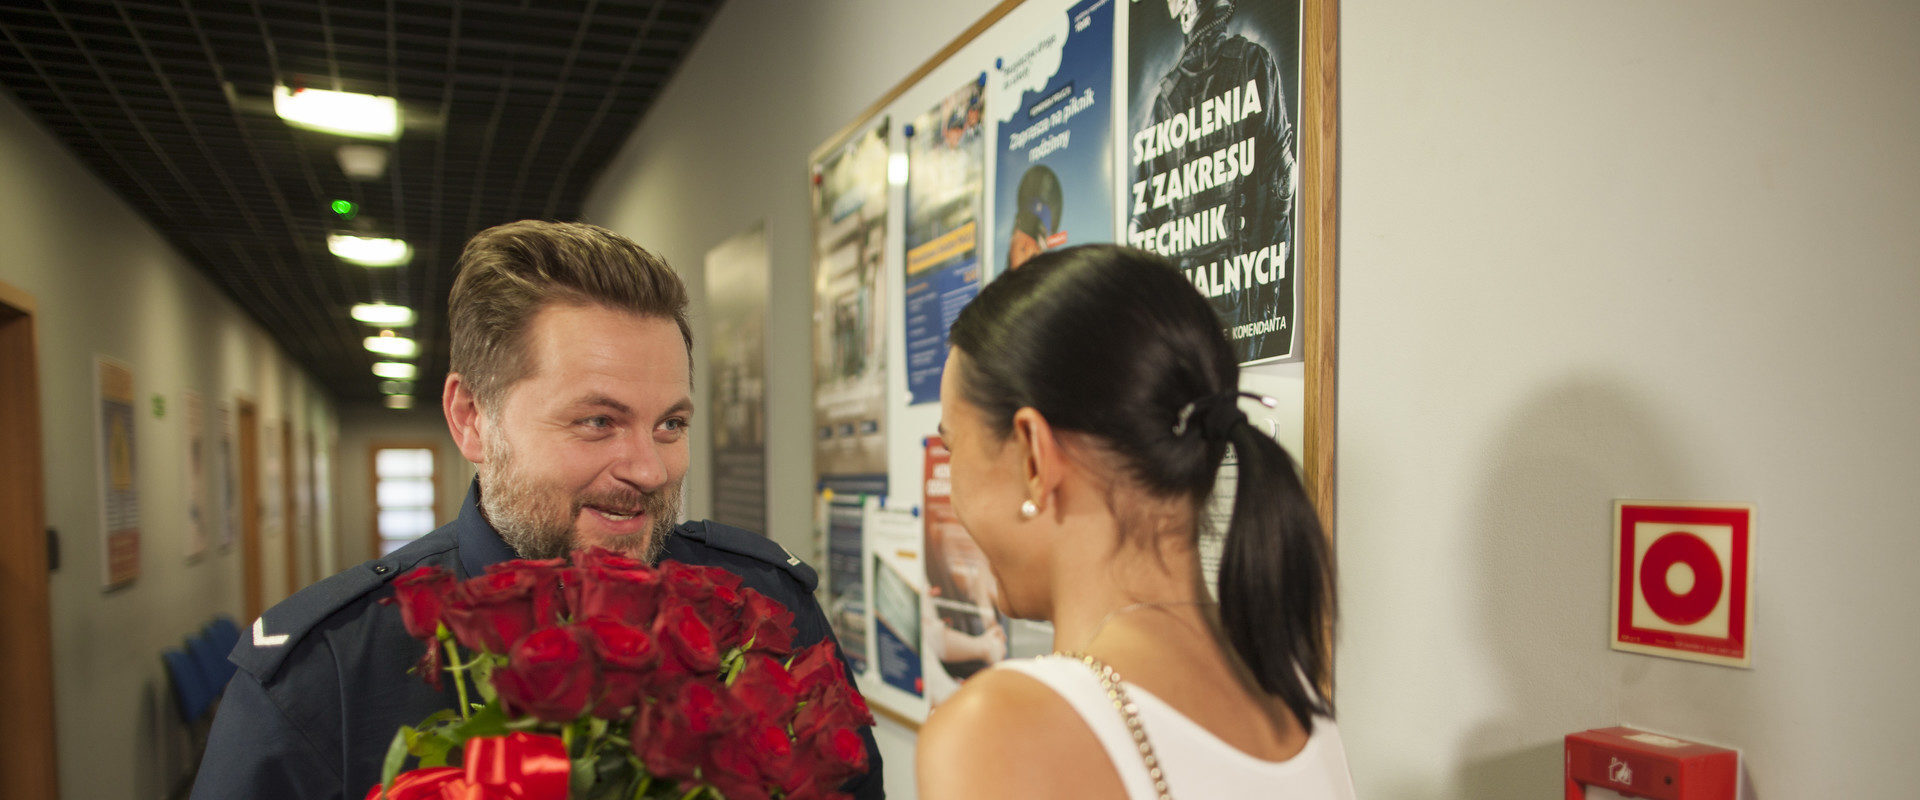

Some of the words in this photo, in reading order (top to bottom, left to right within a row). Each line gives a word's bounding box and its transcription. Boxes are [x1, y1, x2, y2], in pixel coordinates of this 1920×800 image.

[1009, 117, 1050, 151] Zaprasza
[1050, 109, 1063, 127] na
[1063, 87, 1095, 123] piknik
[1028, 129, 1071, 162] rodzinny
[1133, 79, 1262, 166] SZKOLENIA
[1133, 179, 1148, 216] Z
[1152, 137, 1256, 210] ZAKRESU
[1133, 203, 1227, 257] TECHNIK
[1232, 316, 1287, 340] KOMENDANTA
